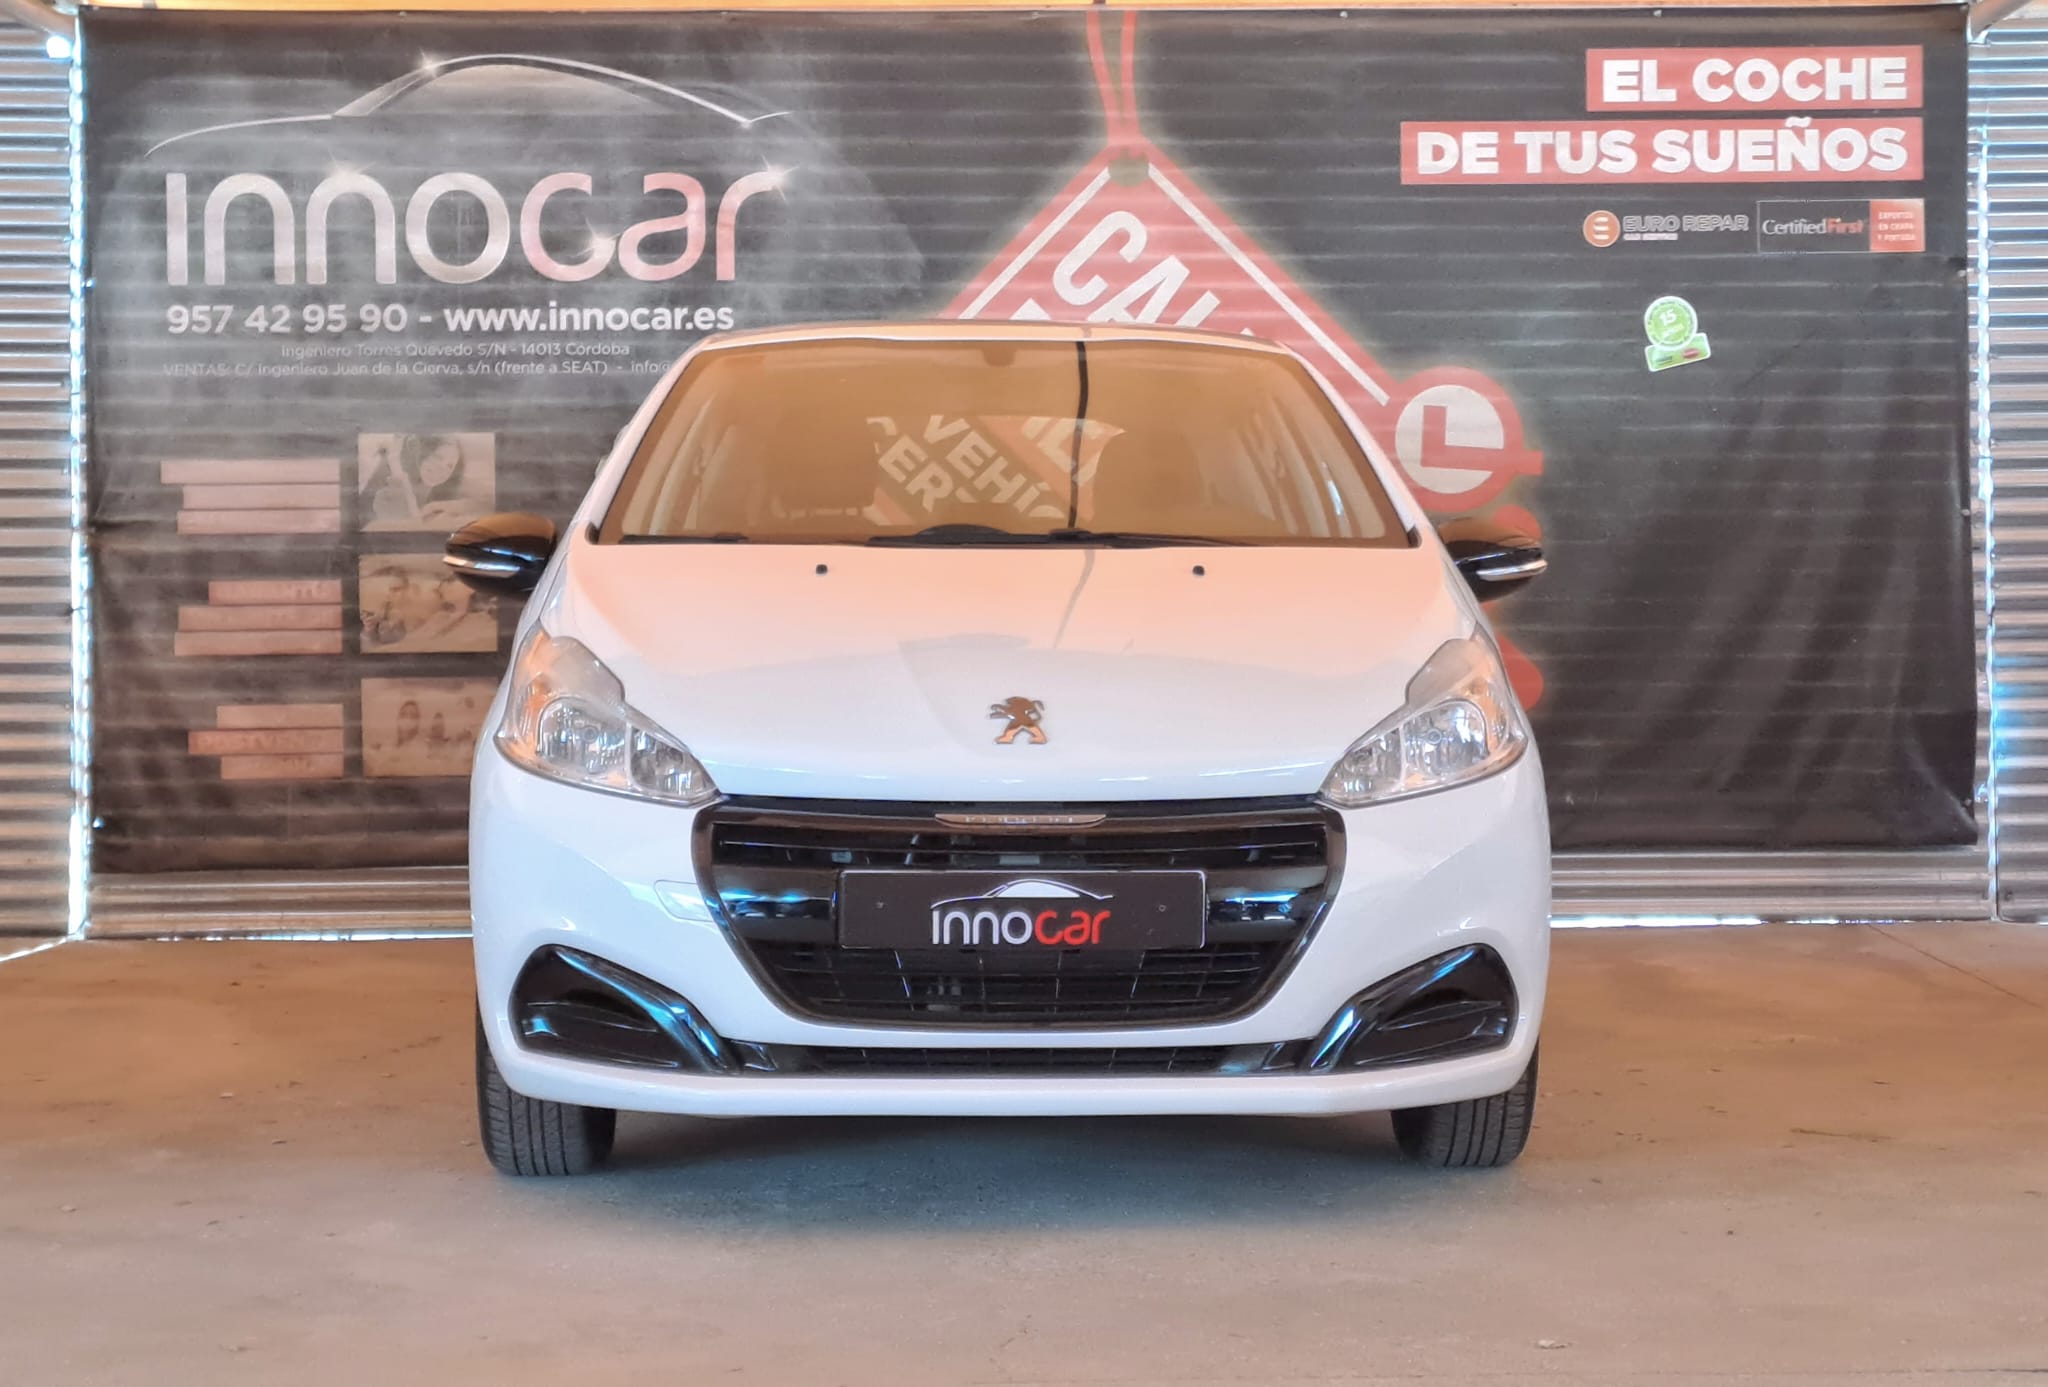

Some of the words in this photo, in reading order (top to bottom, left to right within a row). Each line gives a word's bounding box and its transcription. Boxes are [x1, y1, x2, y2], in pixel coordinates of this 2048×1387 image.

[1602, 59, 1677, 103] EL
[1692, 56, 1909, 102] COCHE
[1416, 131, 1501, 175] DE
[1514, 129, 1639, 175] TUS
[1651, 116, 1909, 174] SUEÑOS
[165, 170, 785, 287] innocar
[1622, 214, 1681, 233] EURO
[1682, 213, 1750, 232] REPAR
[166, 304, 234, 334] 957
[244, 304, 292, 334] 42
[302, 303, 348, 333] 95
[359, 303, 409, 333] 90
[444, 300, 735, 332] www.innocar.es
[281, 344, 353, 361] Ingeniero
[355, 343, 401, 357] Torres
[405, 342, 473, 357] Quevedo
[477, 342, 507, 358] S/N
[521, 342, 561, 356] 14013
[258, 361, 329, 378] Ingeniero
[332, 361, 369, 376] Juan
[372, 361, 393, 376] de
[395, 361, 409, 375] la
[467, 360, 491, 376] s/n
[494, 360, 545, 377] (frente
[549, 364, 558, 375] a
[562, 360, 609, 376] SEAT)
[932, 910, 1112, 945] innocar
